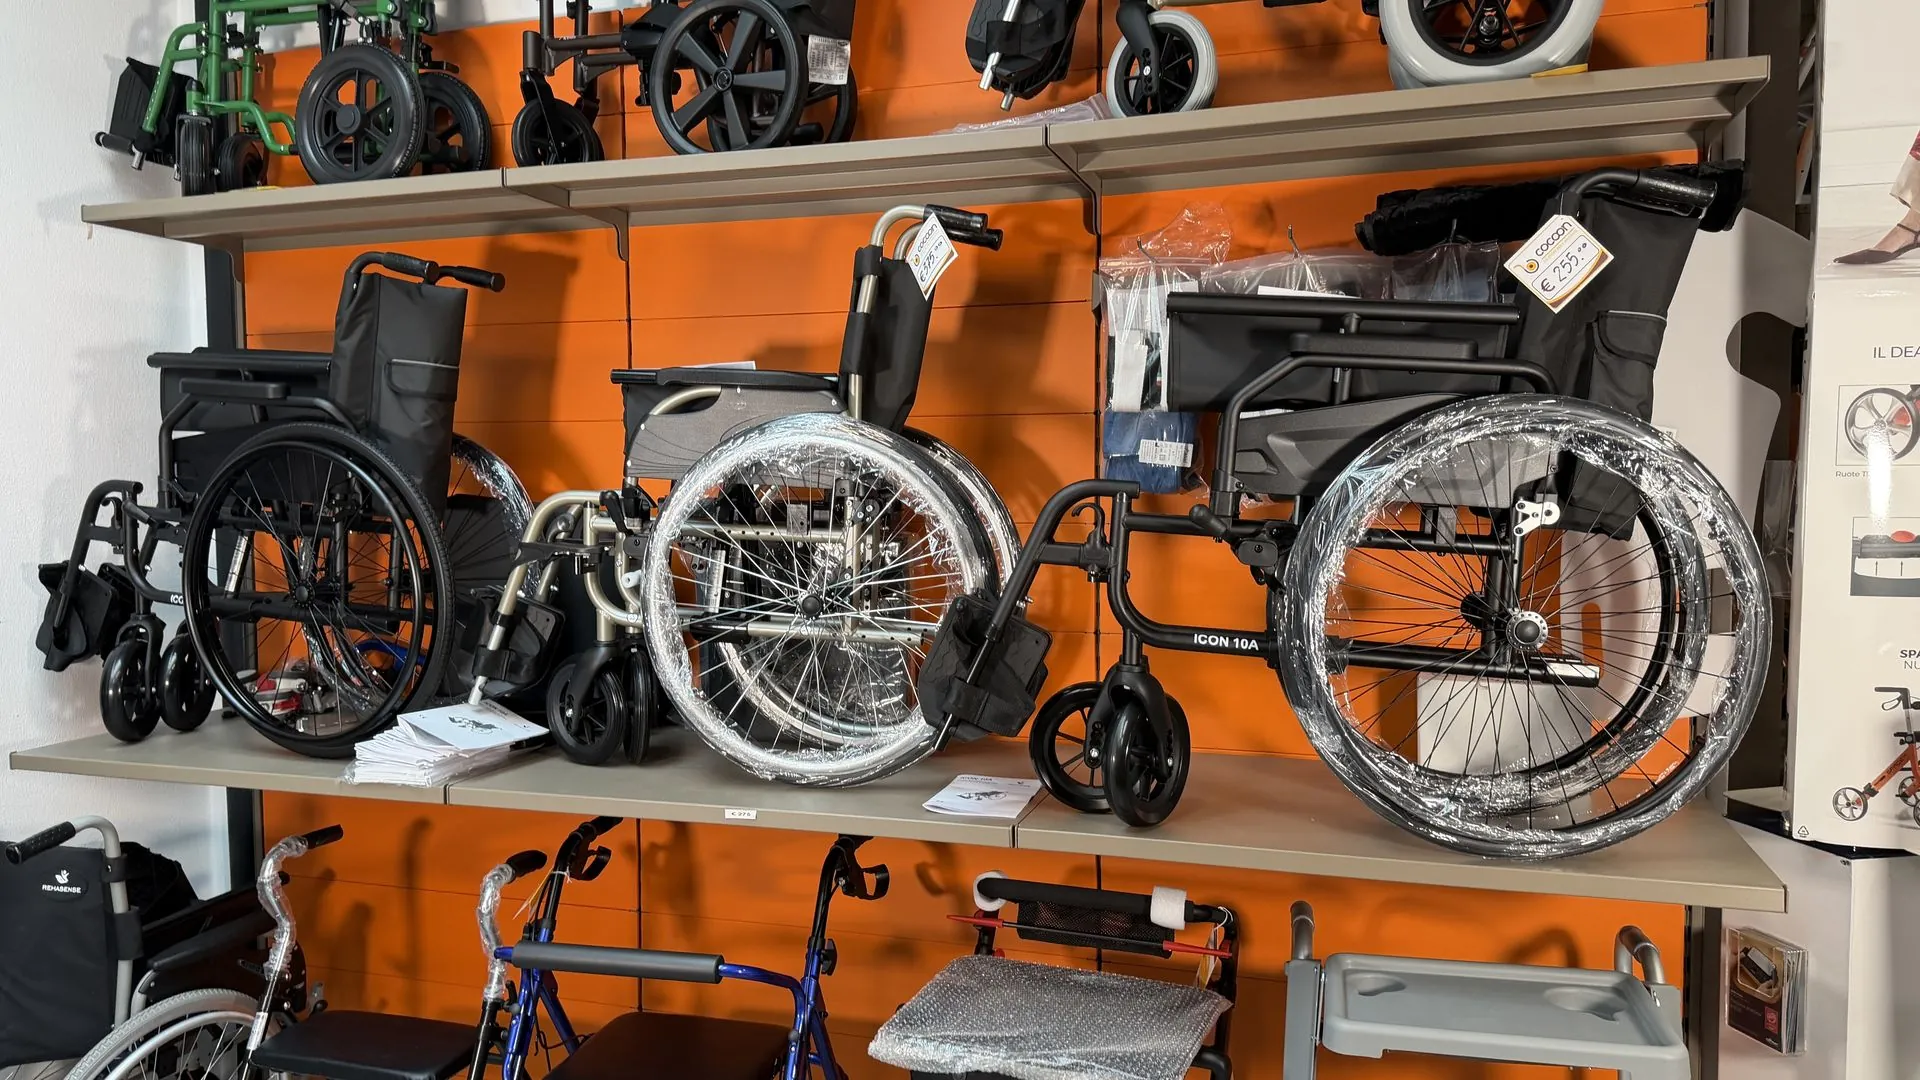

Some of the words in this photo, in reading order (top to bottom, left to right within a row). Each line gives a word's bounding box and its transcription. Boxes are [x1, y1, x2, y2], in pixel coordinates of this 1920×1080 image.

[917, 223, 938, 253] cocoon
[1535, 221, 1573, 257] cocoon
[1540, 278, 1556, 292] €
[1873, 346, 1886, 359] IL
[1193, 633, 1230, 648] ICON
[1233, 637, 1260, 651] 10A
